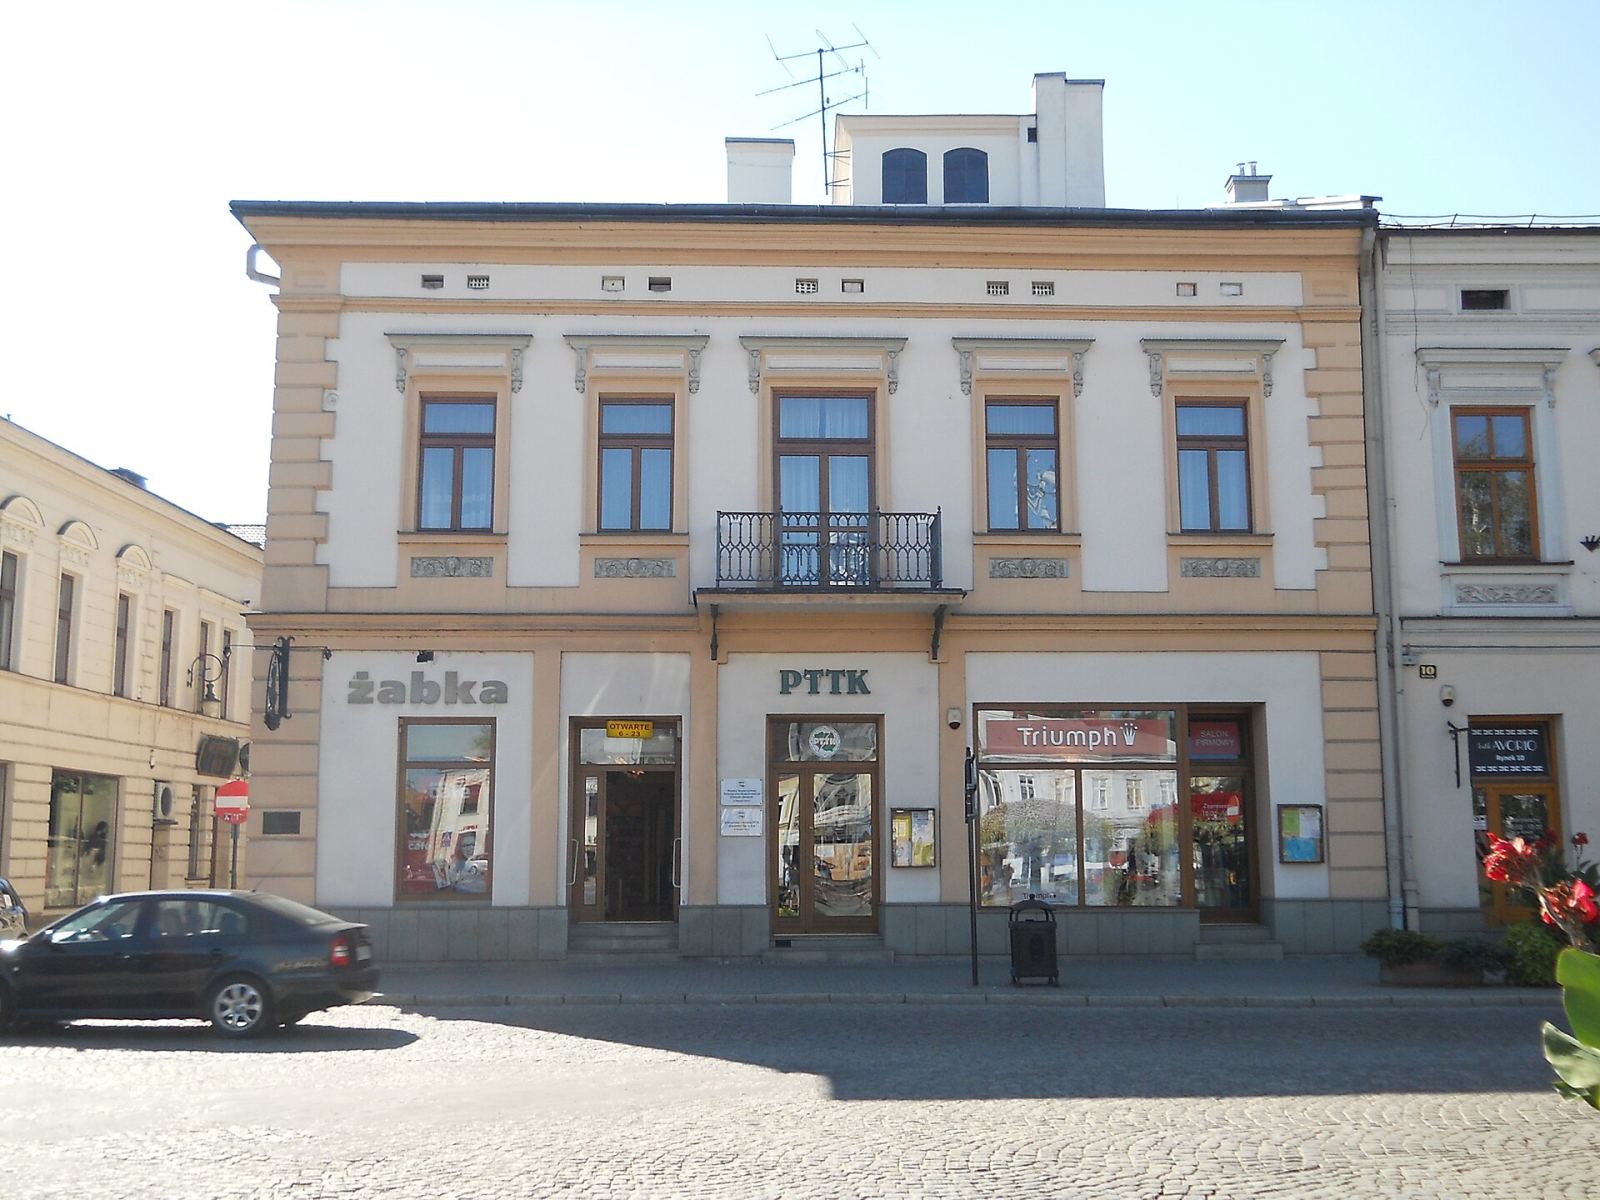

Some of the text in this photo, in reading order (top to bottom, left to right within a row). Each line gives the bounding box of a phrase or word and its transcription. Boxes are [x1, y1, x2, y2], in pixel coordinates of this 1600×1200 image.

[1421, 666, 1435, 675] 10
[780, 669, 871, 694] PTTK
[347, 671, 508, 704] żabka
[609, 723, 650, 731] OTWARTE
[1017, 726, 1117, 751] Triumph
[1200, 730, 1230, 738] SALON
[1195, 738, 1234, 747] FIRMOWY
